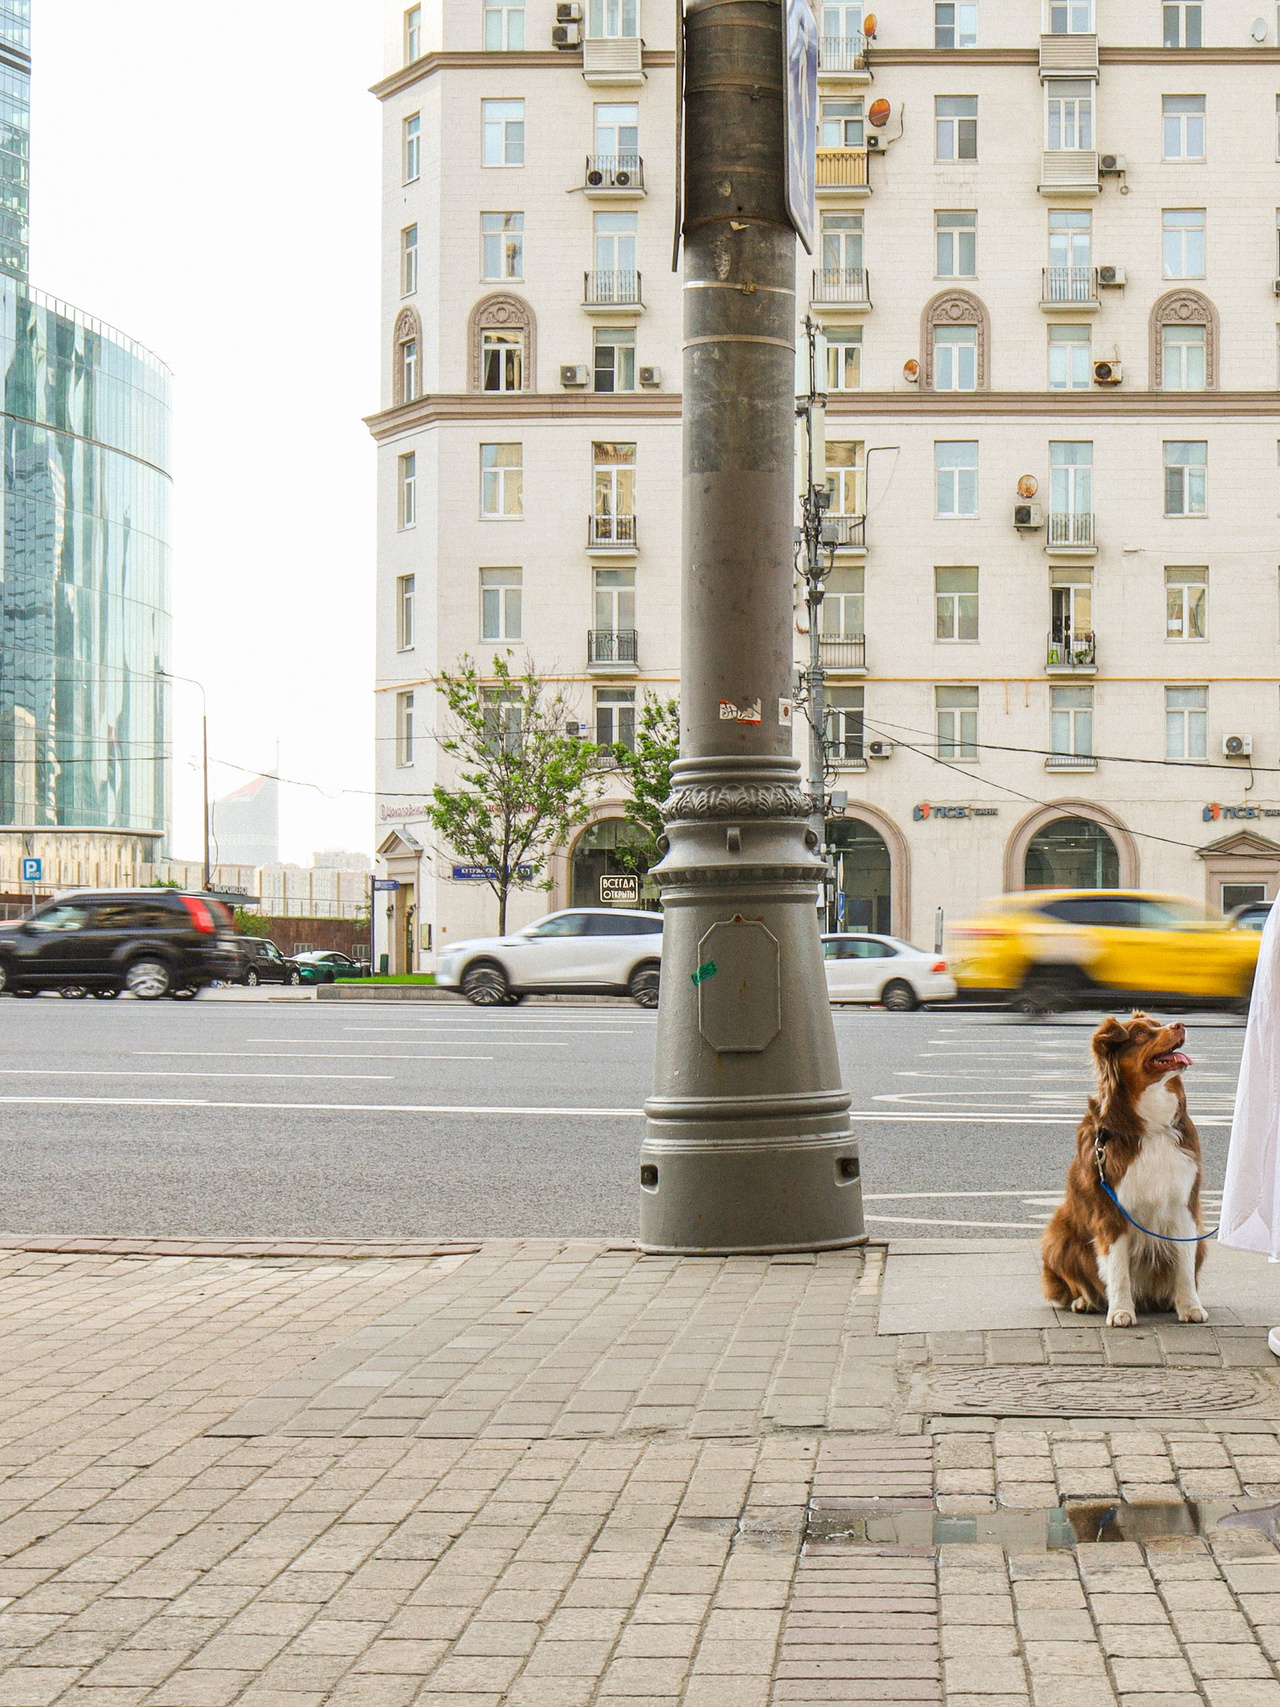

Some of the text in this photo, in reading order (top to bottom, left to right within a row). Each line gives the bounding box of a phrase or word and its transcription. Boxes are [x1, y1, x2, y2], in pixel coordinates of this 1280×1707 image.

[933, 806, 998, 819] ПСБ БАНК
[1223, 807, 1256, 819] ПСБ
[25, 861, 37, 878] P
[603, 879, 635, 888] ВСЕГДА
[603, 890, 635, 899] ОТКРЫТЫ
